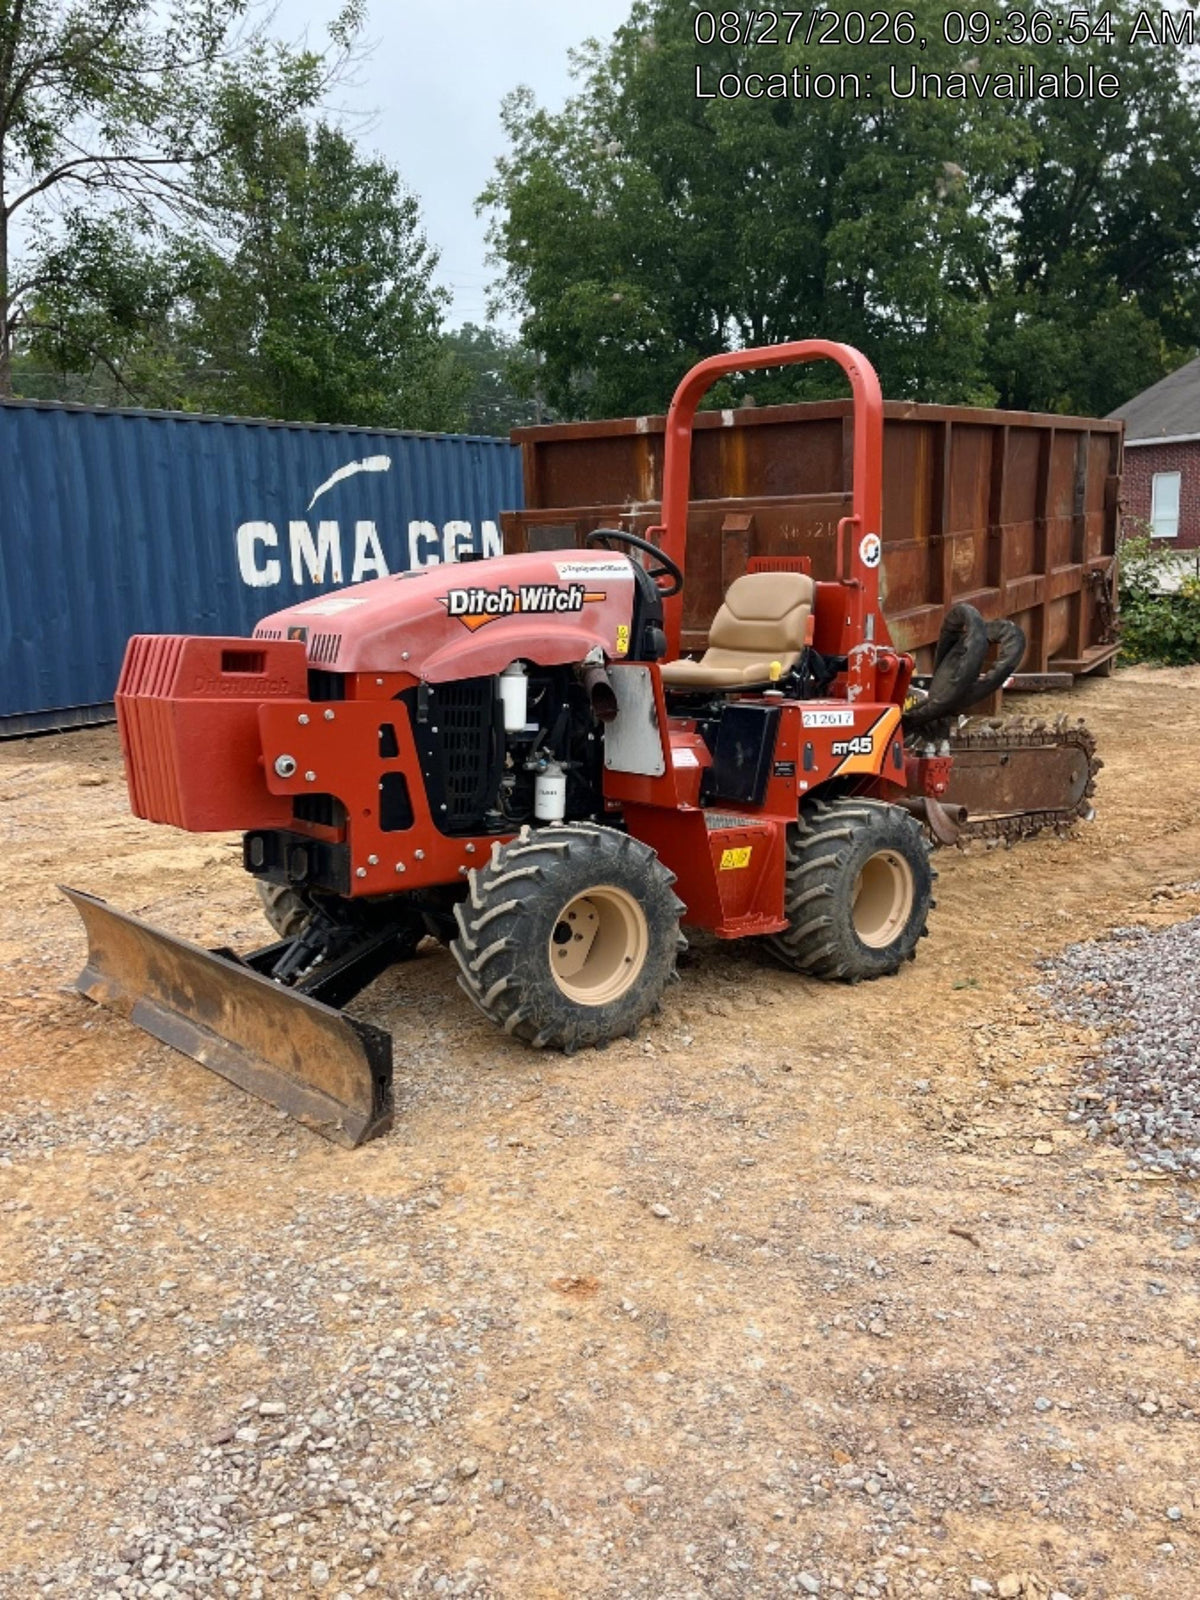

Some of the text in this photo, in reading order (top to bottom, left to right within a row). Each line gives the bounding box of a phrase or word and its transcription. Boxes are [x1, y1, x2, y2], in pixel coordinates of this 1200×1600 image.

[236, 520, 390, 588] CMA
[449, 584, 583, 615] Ditch Witch
[803, 712, 852, 726] 212617
